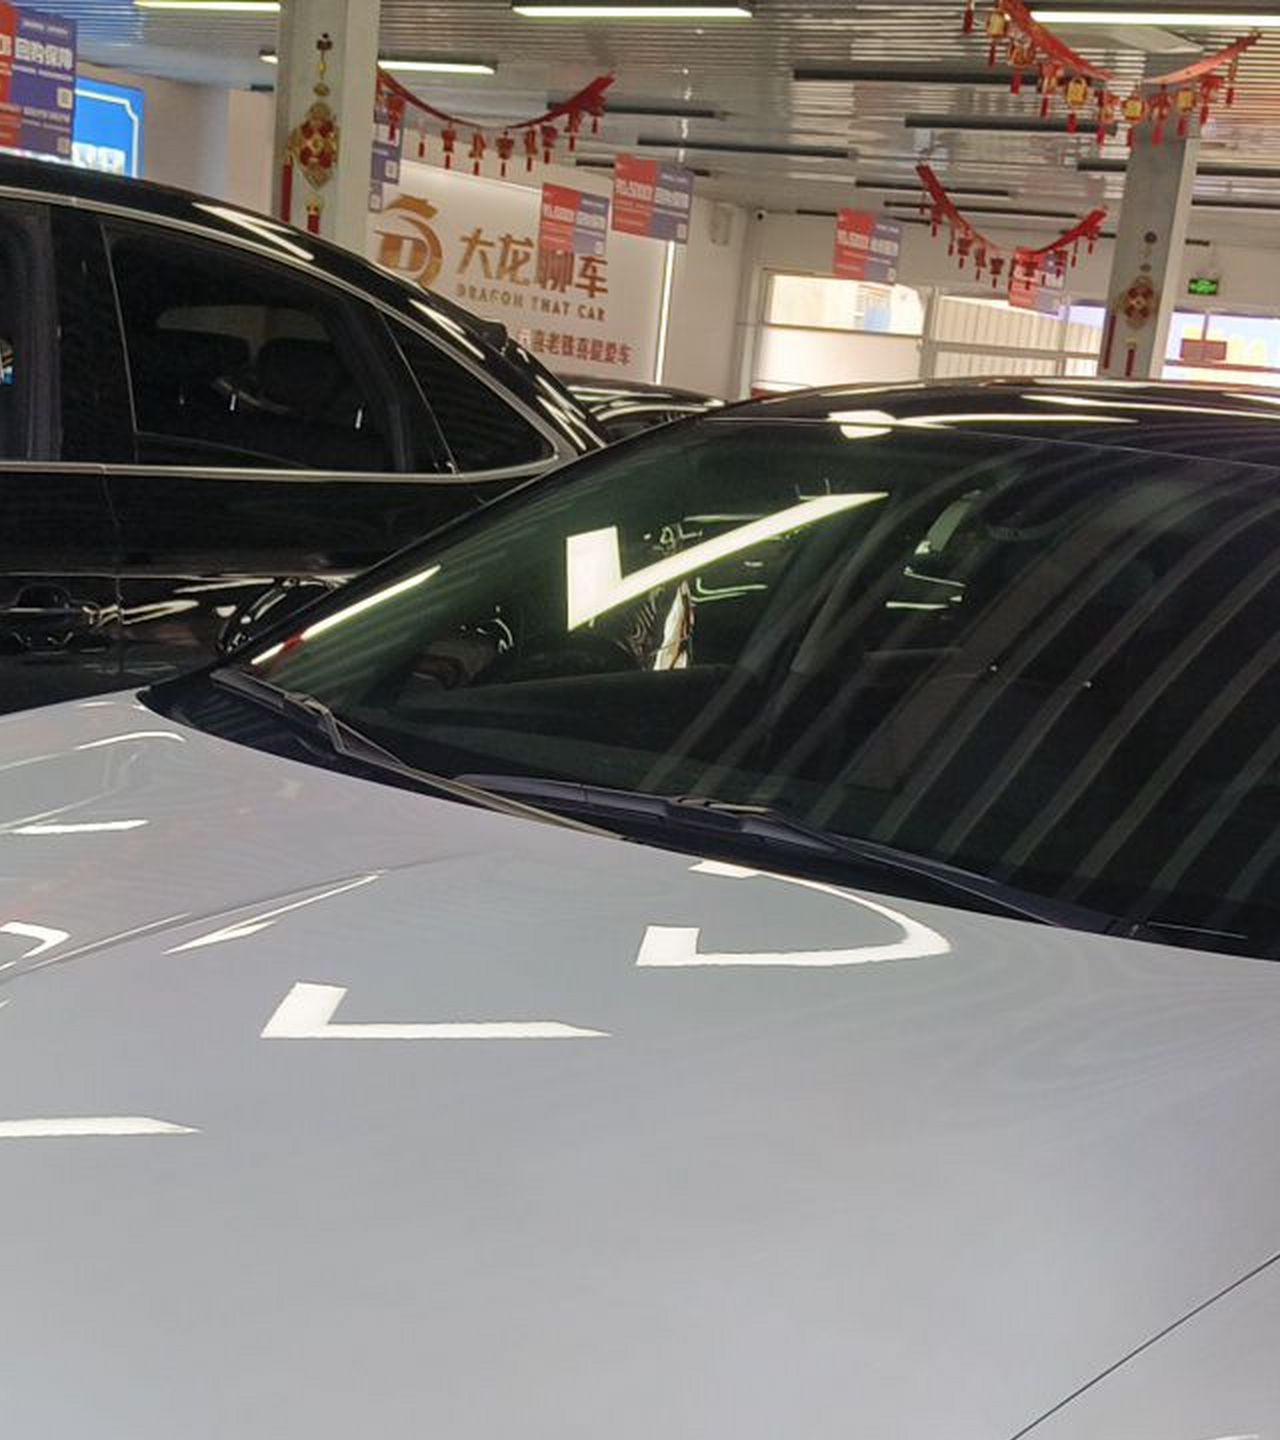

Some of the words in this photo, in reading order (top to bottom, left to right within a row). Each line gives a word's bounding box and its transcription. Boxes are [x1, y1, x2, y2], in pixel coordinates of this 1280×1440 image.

[455, 282, 524, 308] DRAGON
[531, 296, 571, 317] THAT
[577, 304, 606, 322] CAR
